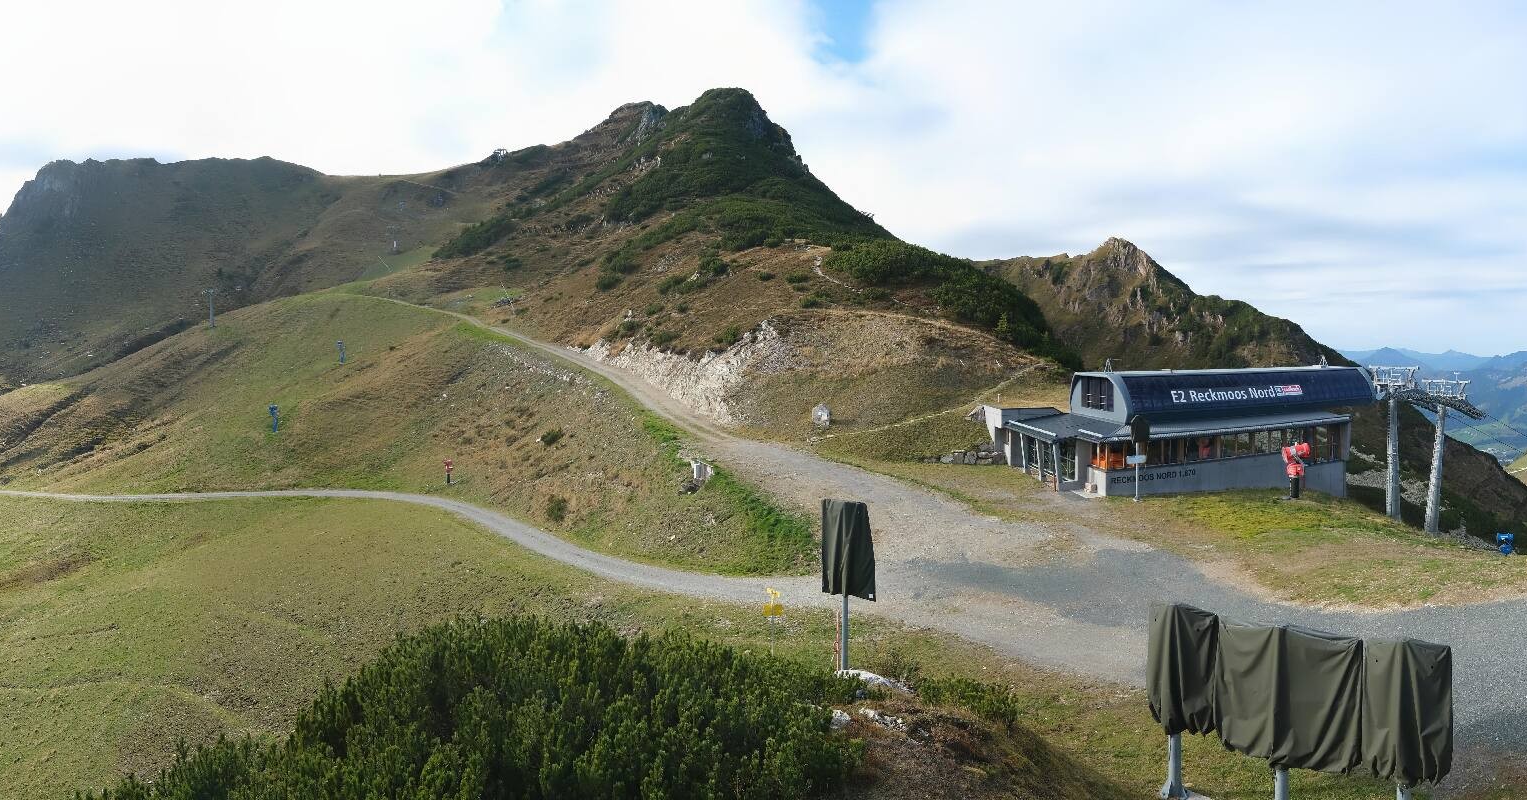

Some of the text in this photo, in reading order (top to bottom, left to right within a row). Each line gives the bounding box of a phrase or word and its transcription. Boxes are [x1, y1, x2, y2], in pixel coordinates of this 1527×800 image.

[1171, 390, 1187, 403] E2
[1189, 388, 1248, 402] Reckmoos
[1248, 385, 1276, 399] Nord
[1156, 471, 1177, 480] NORD
